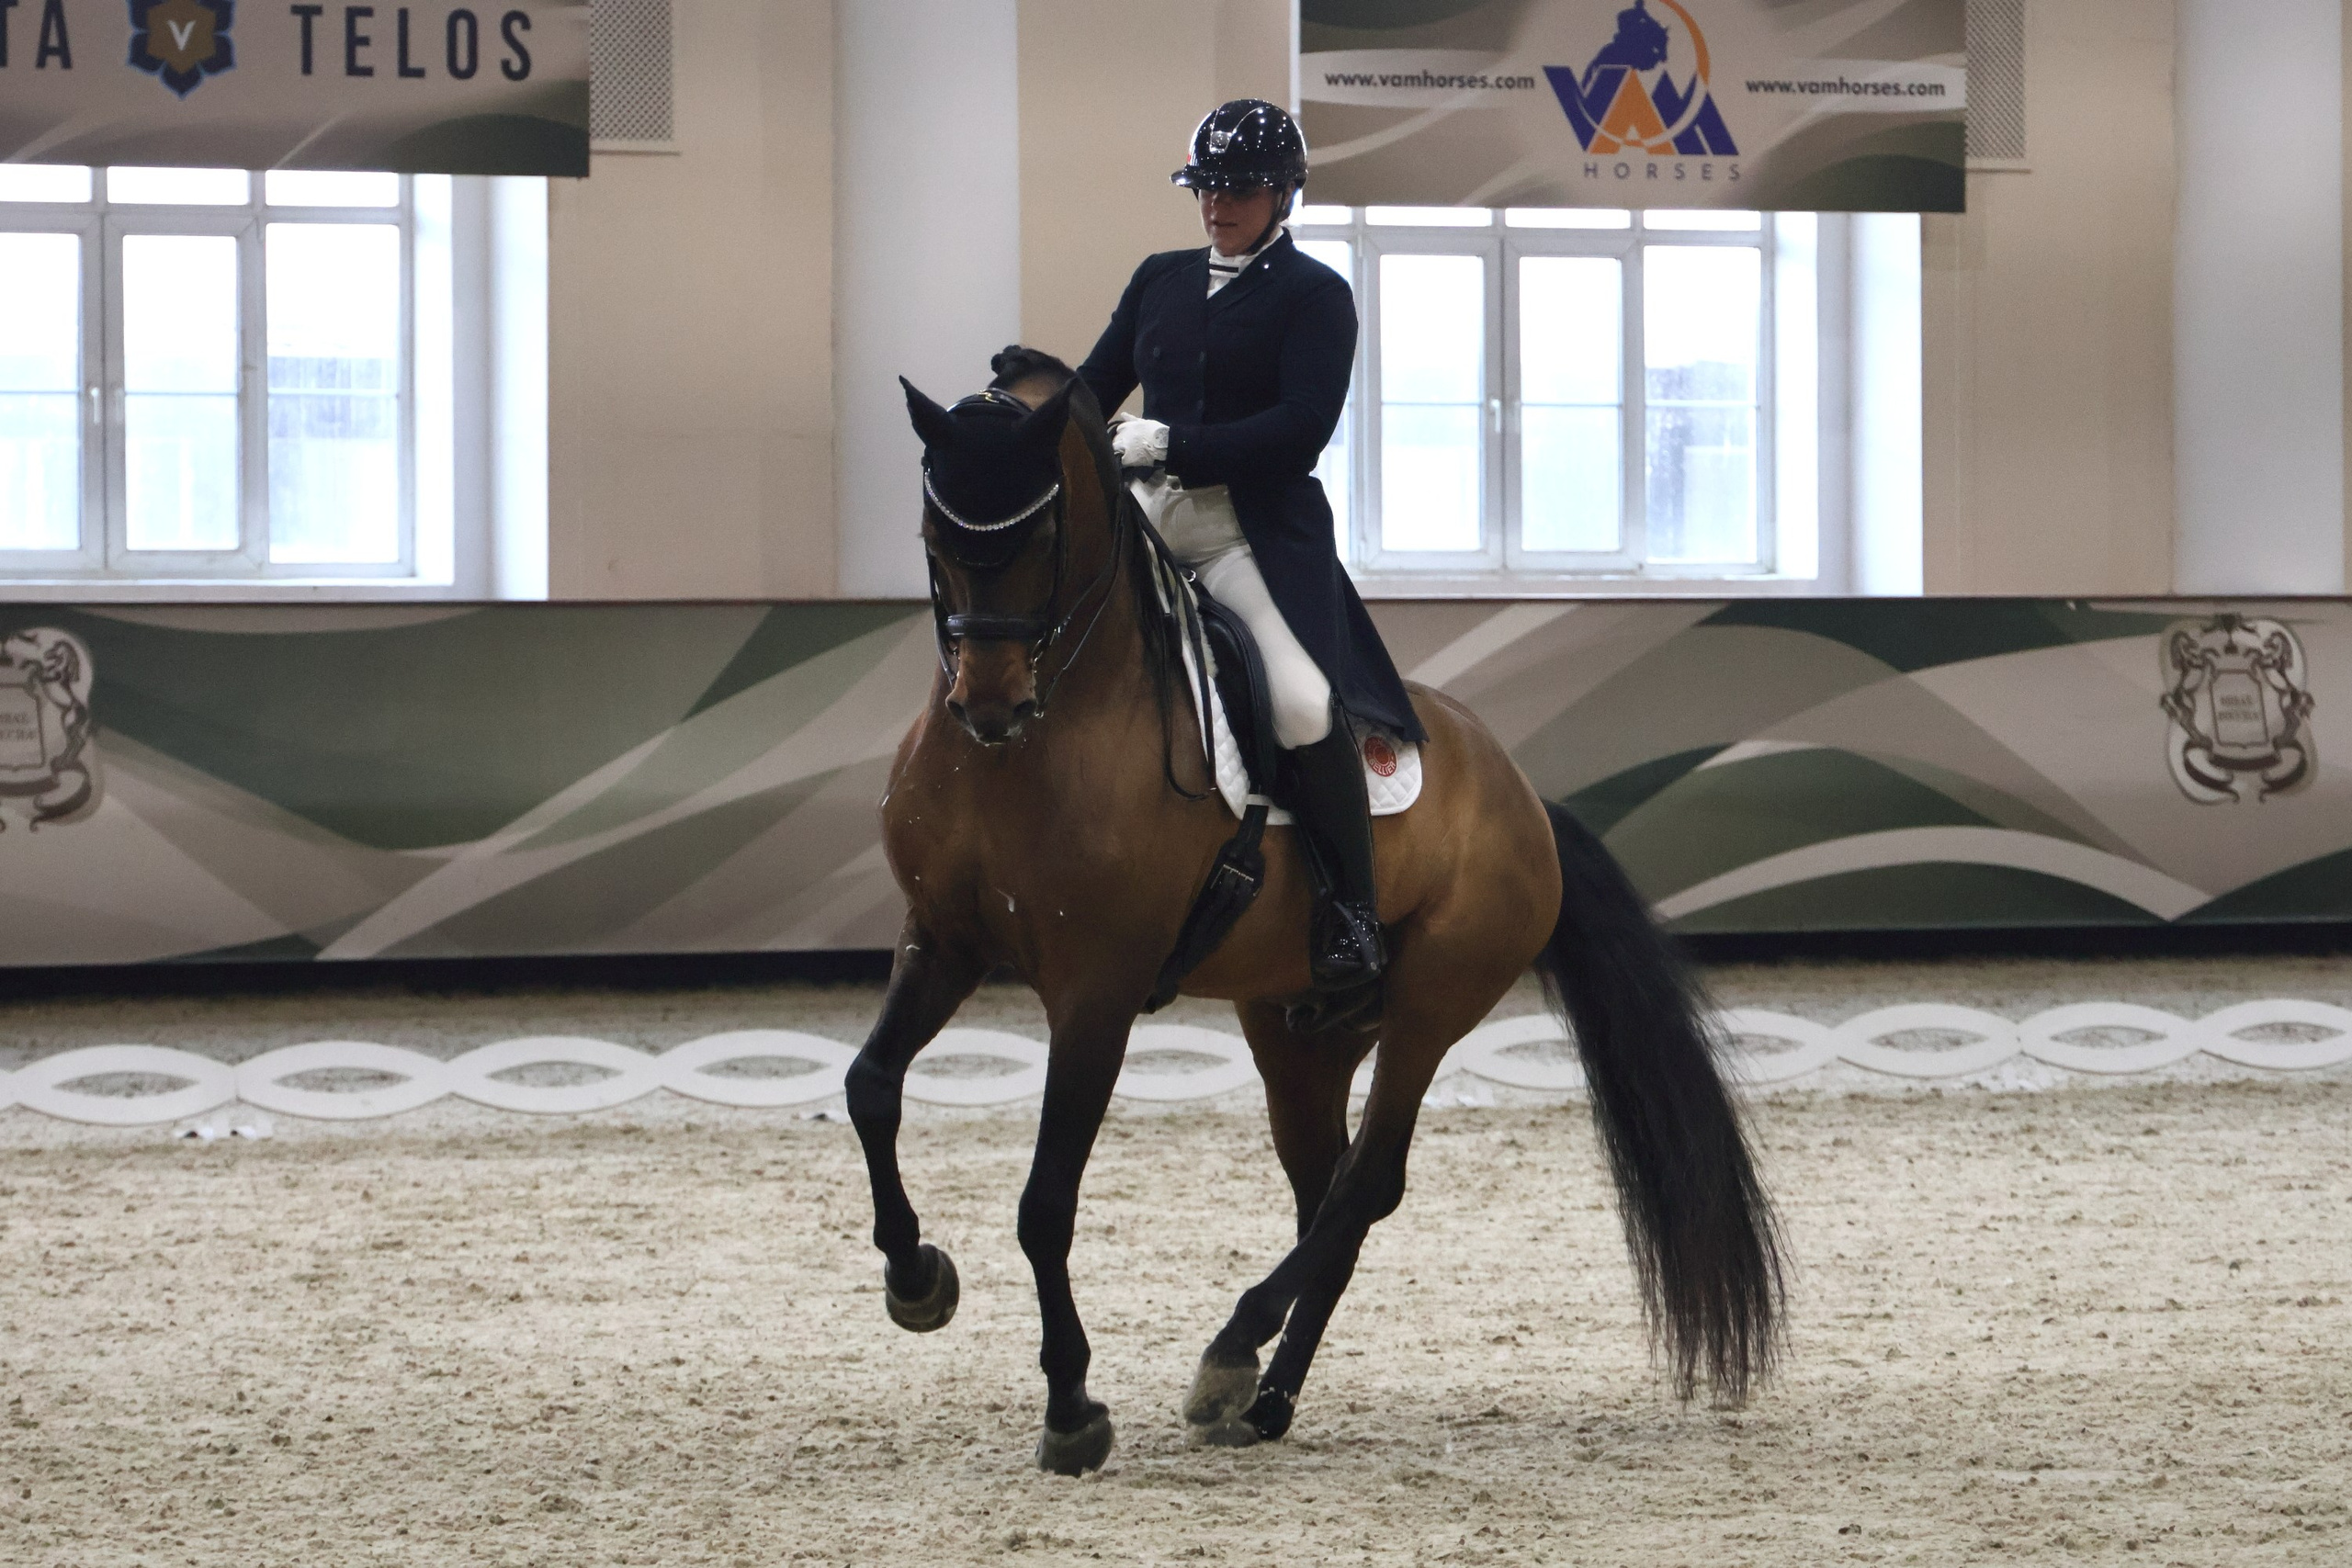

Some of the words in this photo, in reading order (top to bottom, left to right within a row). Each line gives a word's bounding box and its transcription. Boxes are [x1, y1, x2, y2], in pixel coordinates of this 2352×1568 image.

[290, 5, 532, 81] TELOS
[1325, 69, 1534, 89] www.vamhorses.com
[1746, 76, 1946, 96] www.vamhorses.com
[1584, 162, 1740, 180] HORSES
[1369, 759, 1396, 775] SELLIER
